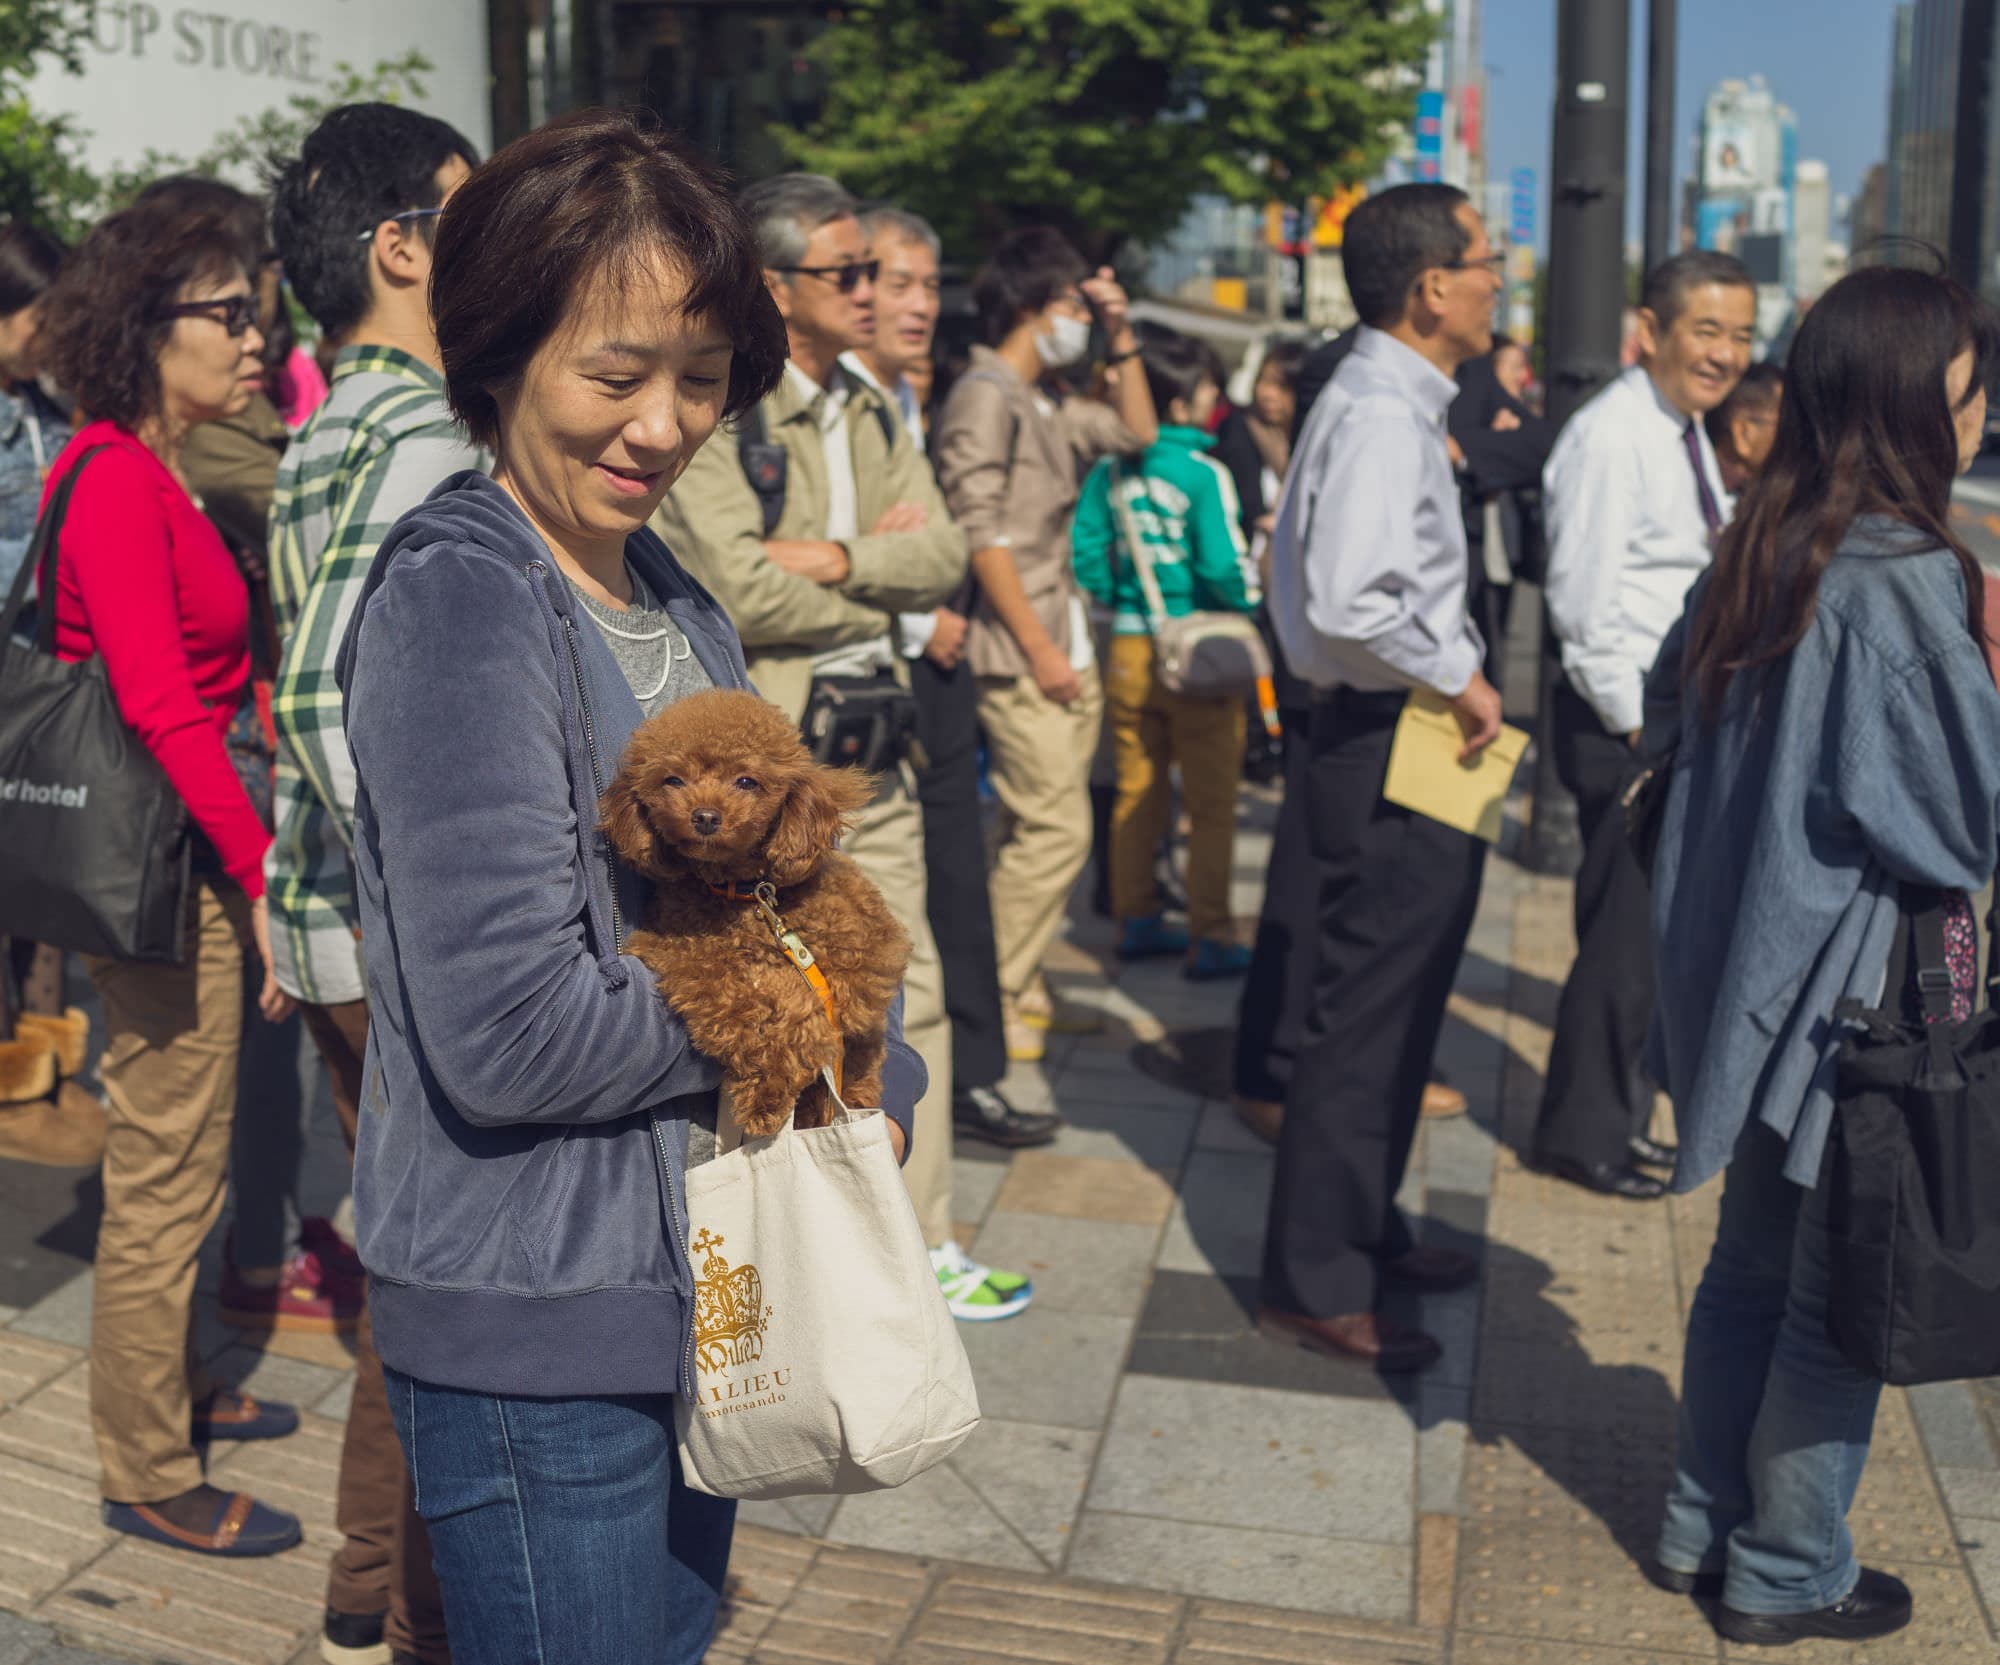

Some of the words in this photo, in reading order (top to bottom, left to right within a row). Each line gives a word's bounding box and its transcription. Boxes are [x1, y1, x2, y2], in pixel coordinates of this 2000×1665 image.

[173, 8, 322, 84] STORE
[20, 778, 88, 808] hotel
[697, 1368, 791, 1406] ILIEU
